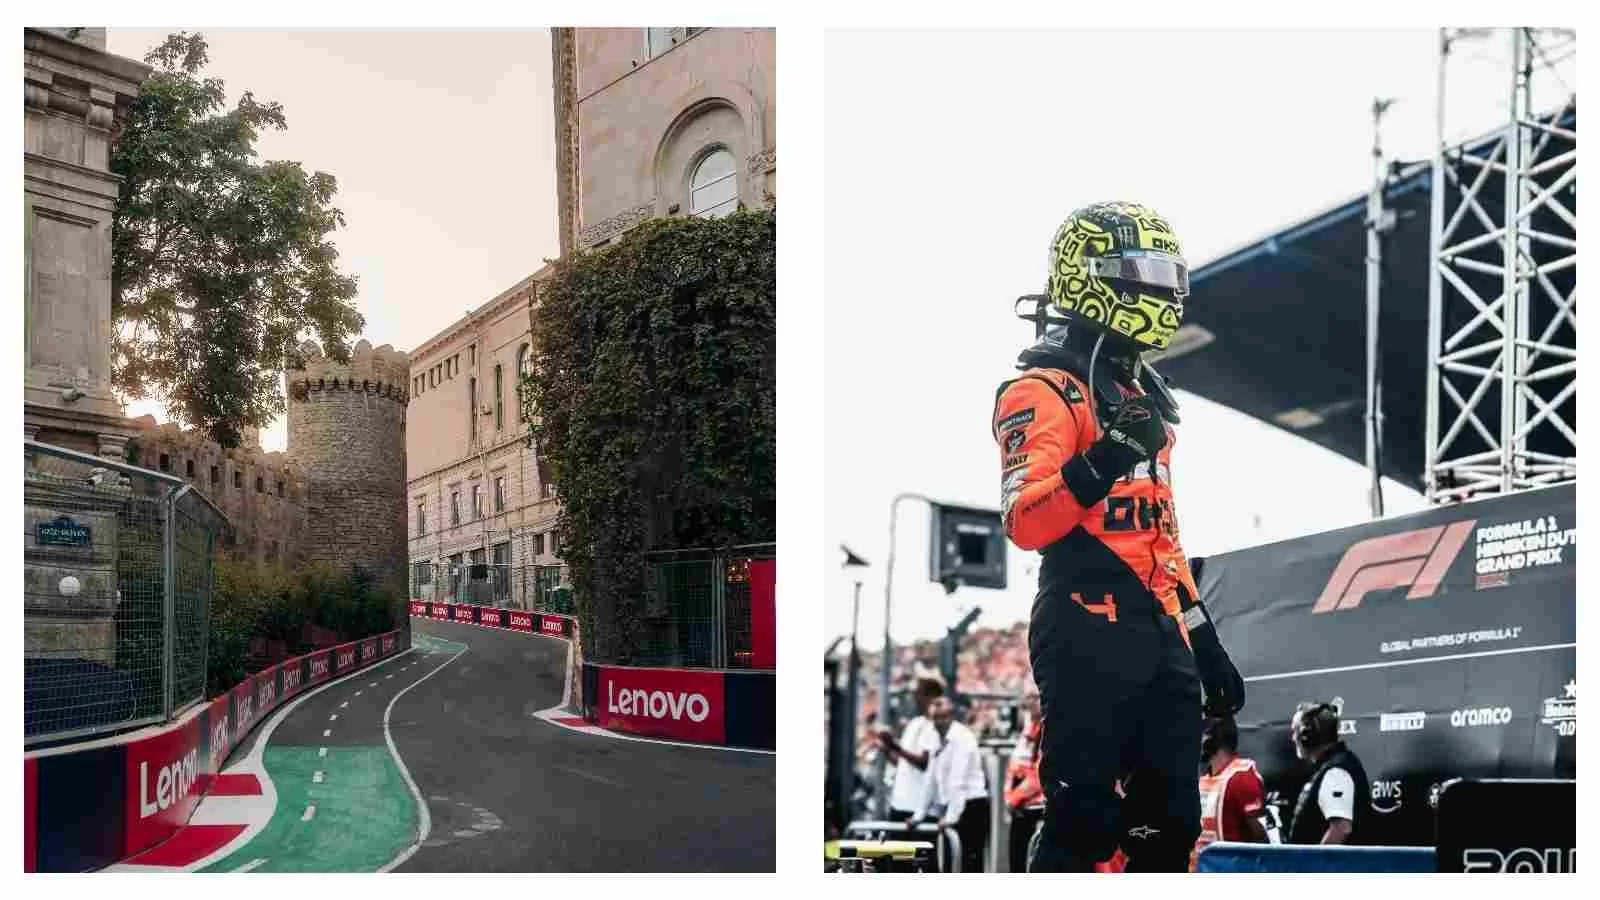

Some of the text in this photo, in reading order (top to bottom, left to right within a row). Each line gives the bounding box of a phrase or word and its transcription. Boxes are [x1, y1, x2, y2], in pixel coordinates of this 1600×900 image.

[1476, 515, 1558, 543] FORMULA 1
[1476, 533, 1546, 560] HEINEKEN
[1312, 520, 1477, 615] F1
[1476, 547, 1562, 574] GRAND PRIX
[608, 679, 710, 723] Lenovo
[1451, 706, 1512, 728] aramco
[140, 747, 200, 819] Lenovo
[1372, 780, 1402, 800] aws
